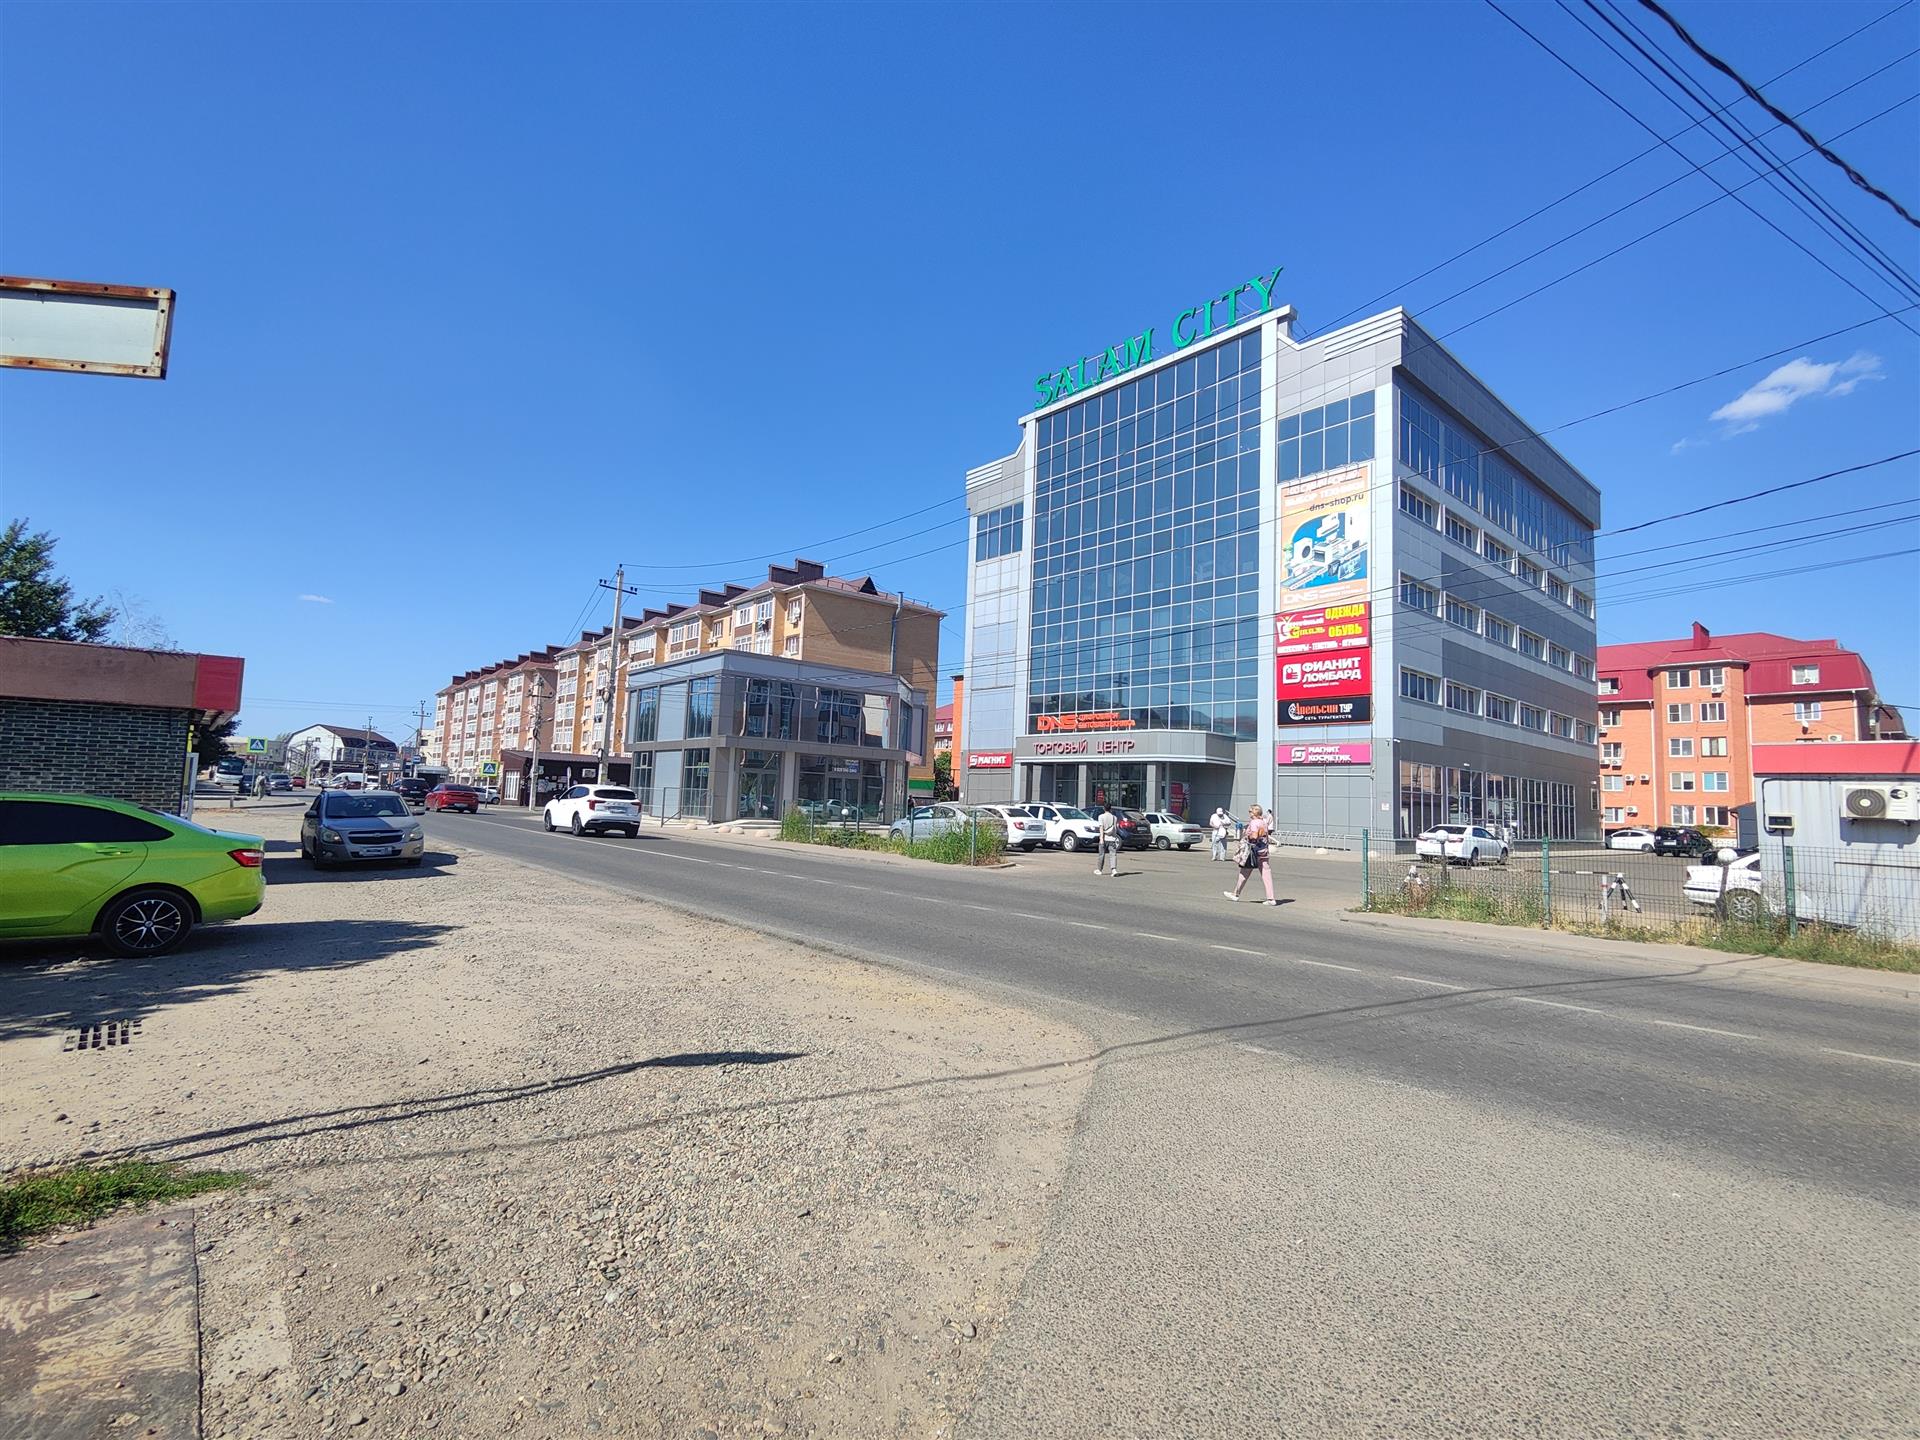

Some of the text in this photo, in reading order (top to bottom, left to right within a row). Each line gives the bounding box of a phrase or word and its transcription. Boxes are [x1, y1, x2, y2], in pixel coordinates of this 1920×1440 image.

[1034, 265, 1284, 409] SALAM CITY
[1309, 493, 1364, 511] dns-shop.ru
[1325, 603, 1366, 620] ОДЕЖДА
[1328, 623, 1363, 638] ОБУВЬ
[1302, 657, 1362, 672] ФИАНИТ
[1302, 668, 1362, 683] ЛОМБАРД
[1338, 703, 1353, 713] ТУР
[1037, 714, 1078, 731] DNS
[1034, 738, 1135, 755] ТОРГОВЫЙ ЦЕНТР
[978, 755, 1007, 764] МАГНИТ
